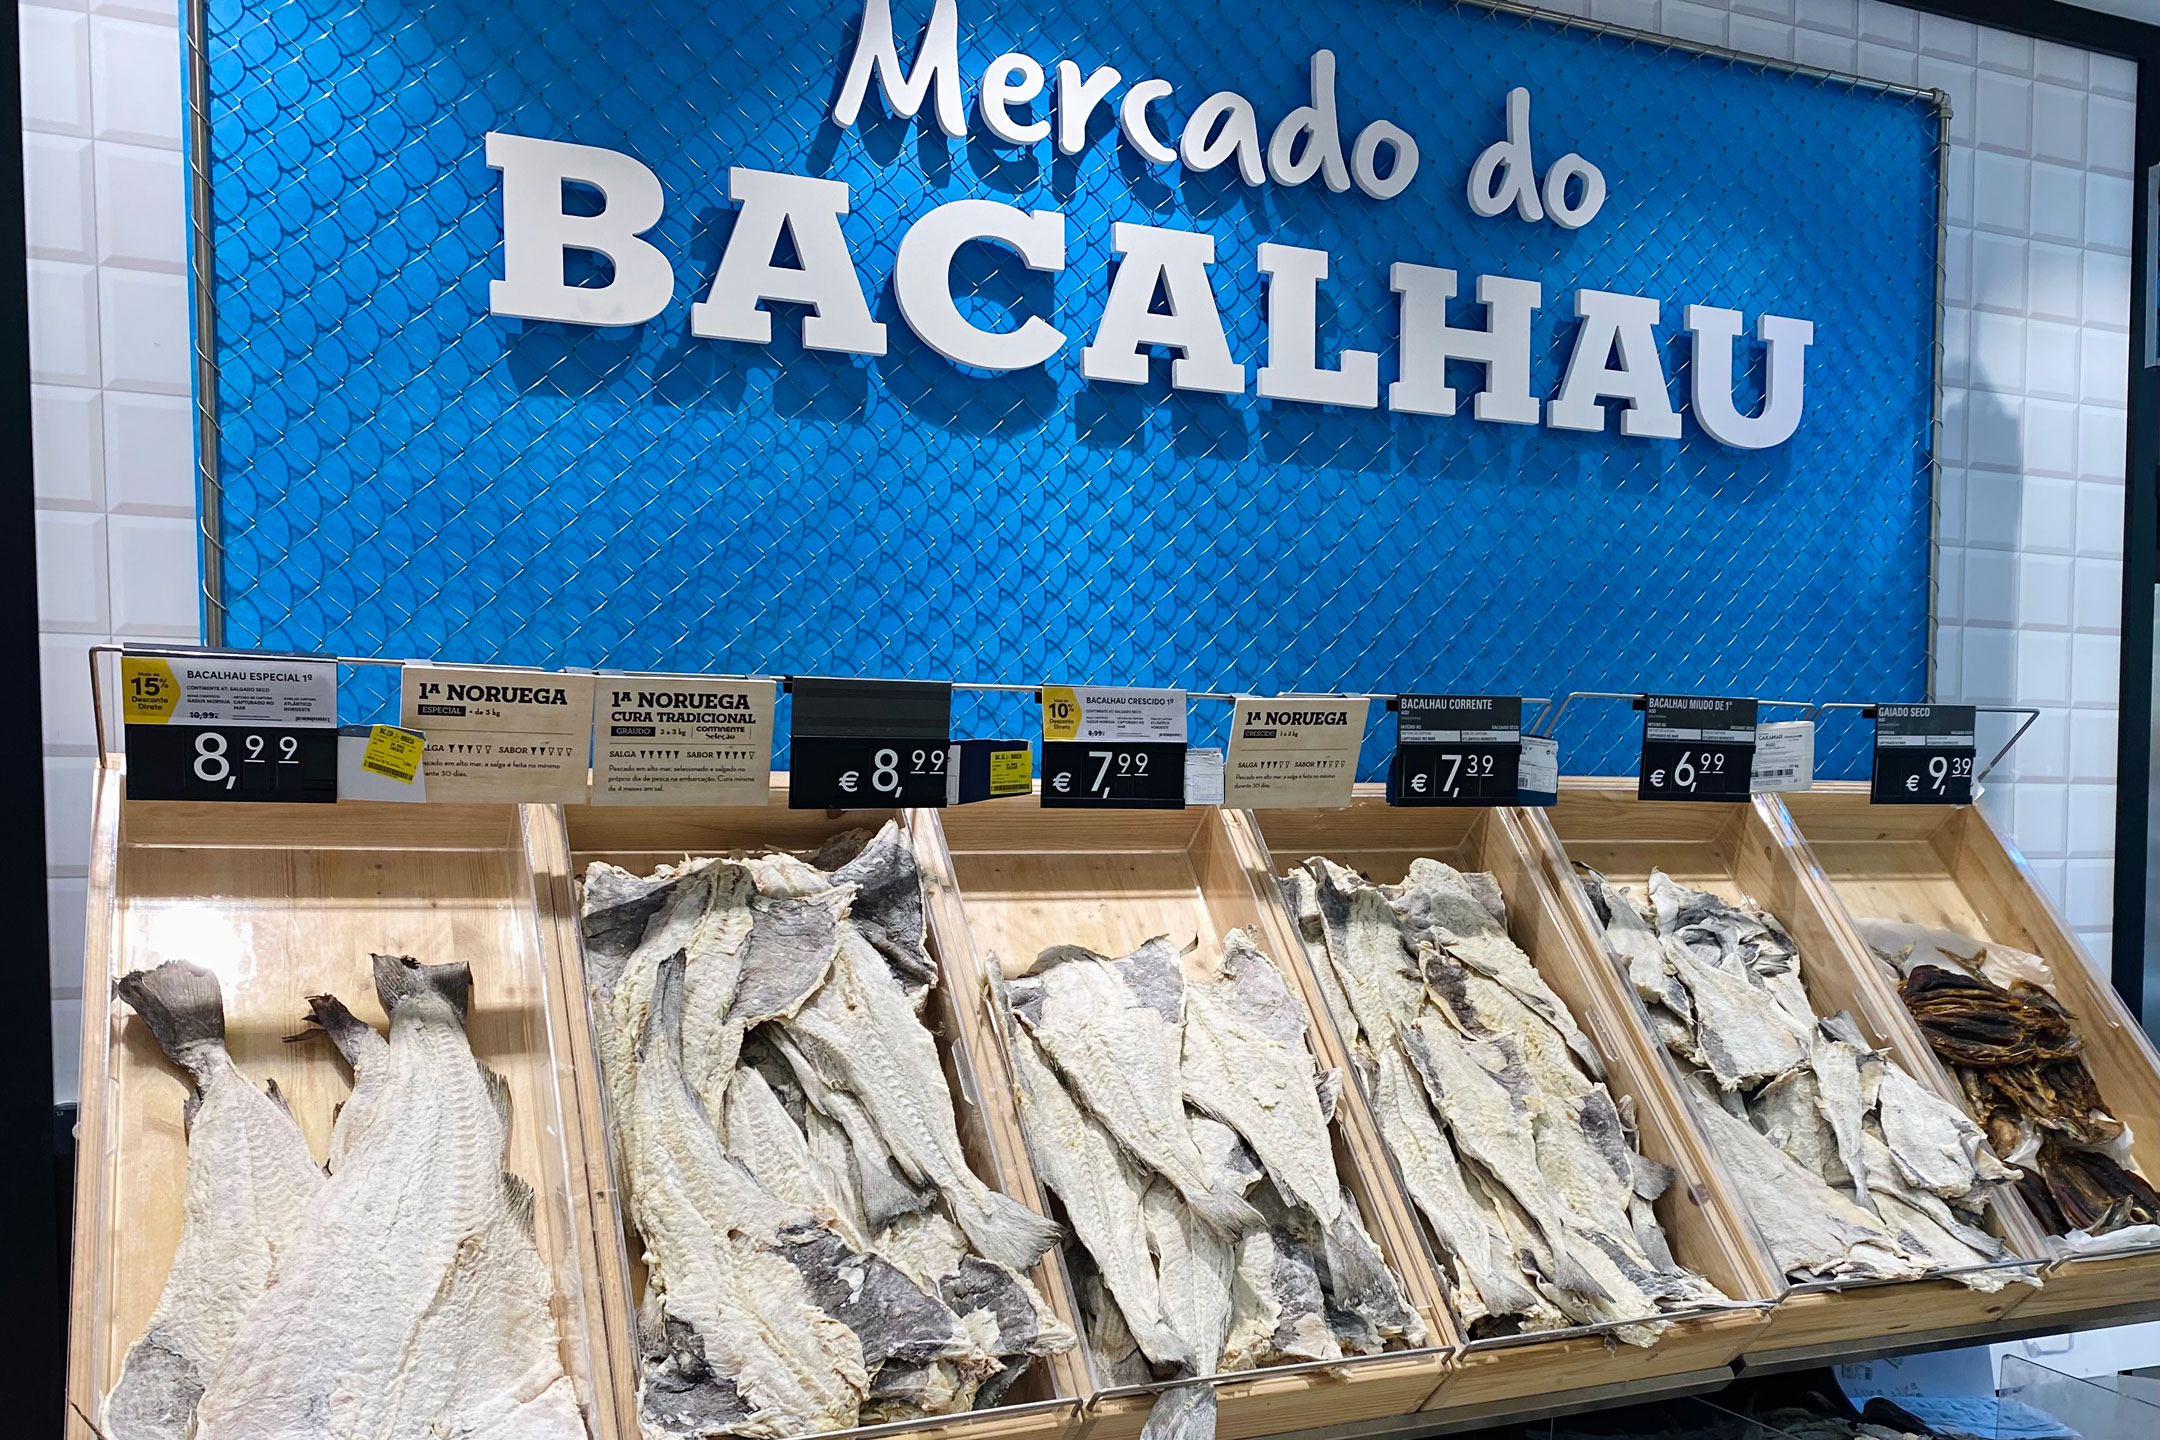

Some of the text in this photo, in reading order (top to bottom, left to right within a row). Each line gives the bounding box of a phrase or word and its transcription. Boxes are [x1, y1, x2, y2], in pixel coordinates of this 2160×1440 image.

[833, 0, 1606, 230] Mercado do
[486, 131, 1814, 450] BACALHAU
[187, 670, 246, 680] BACALHAU
[250, 672, 300, 682] ESPECIAL
[131, 677, 169, 696] 15%
[446, 684, 568, 705] NORUEGA
[637, 692, 750, 710] NORUEGA
[1401, 699, 1492, 710] BACALHAU CORRENTE
[1649, 698, 1688, 709] BACALHAU
[1715, 701, 1724, 710] DE
[422, 706, 462, 714] ESPECIAL
[492, 708, 500, 717] kg
[612, 711, 756, 724] CURA TRADICIONAL
[1049, 703, 1074, 718] 10%
[1264, 712, 1348, 726] NORUEGA
[1878, 707, 1930, 717] GAIADO SECO
[678, 728, 686, 736] kg
[839, 748, 944, 798] € 8,99
[1052, 772, 1072, 792] €
[1089, 751, 1148, 799] 7,99
[1411, 773, 1428, 792] €
[1441, 754, 1493, 798] 7,39
[1650, 751, 1724, 792] € 6,99
[1906, 756, 1971, 795] € 9,39
